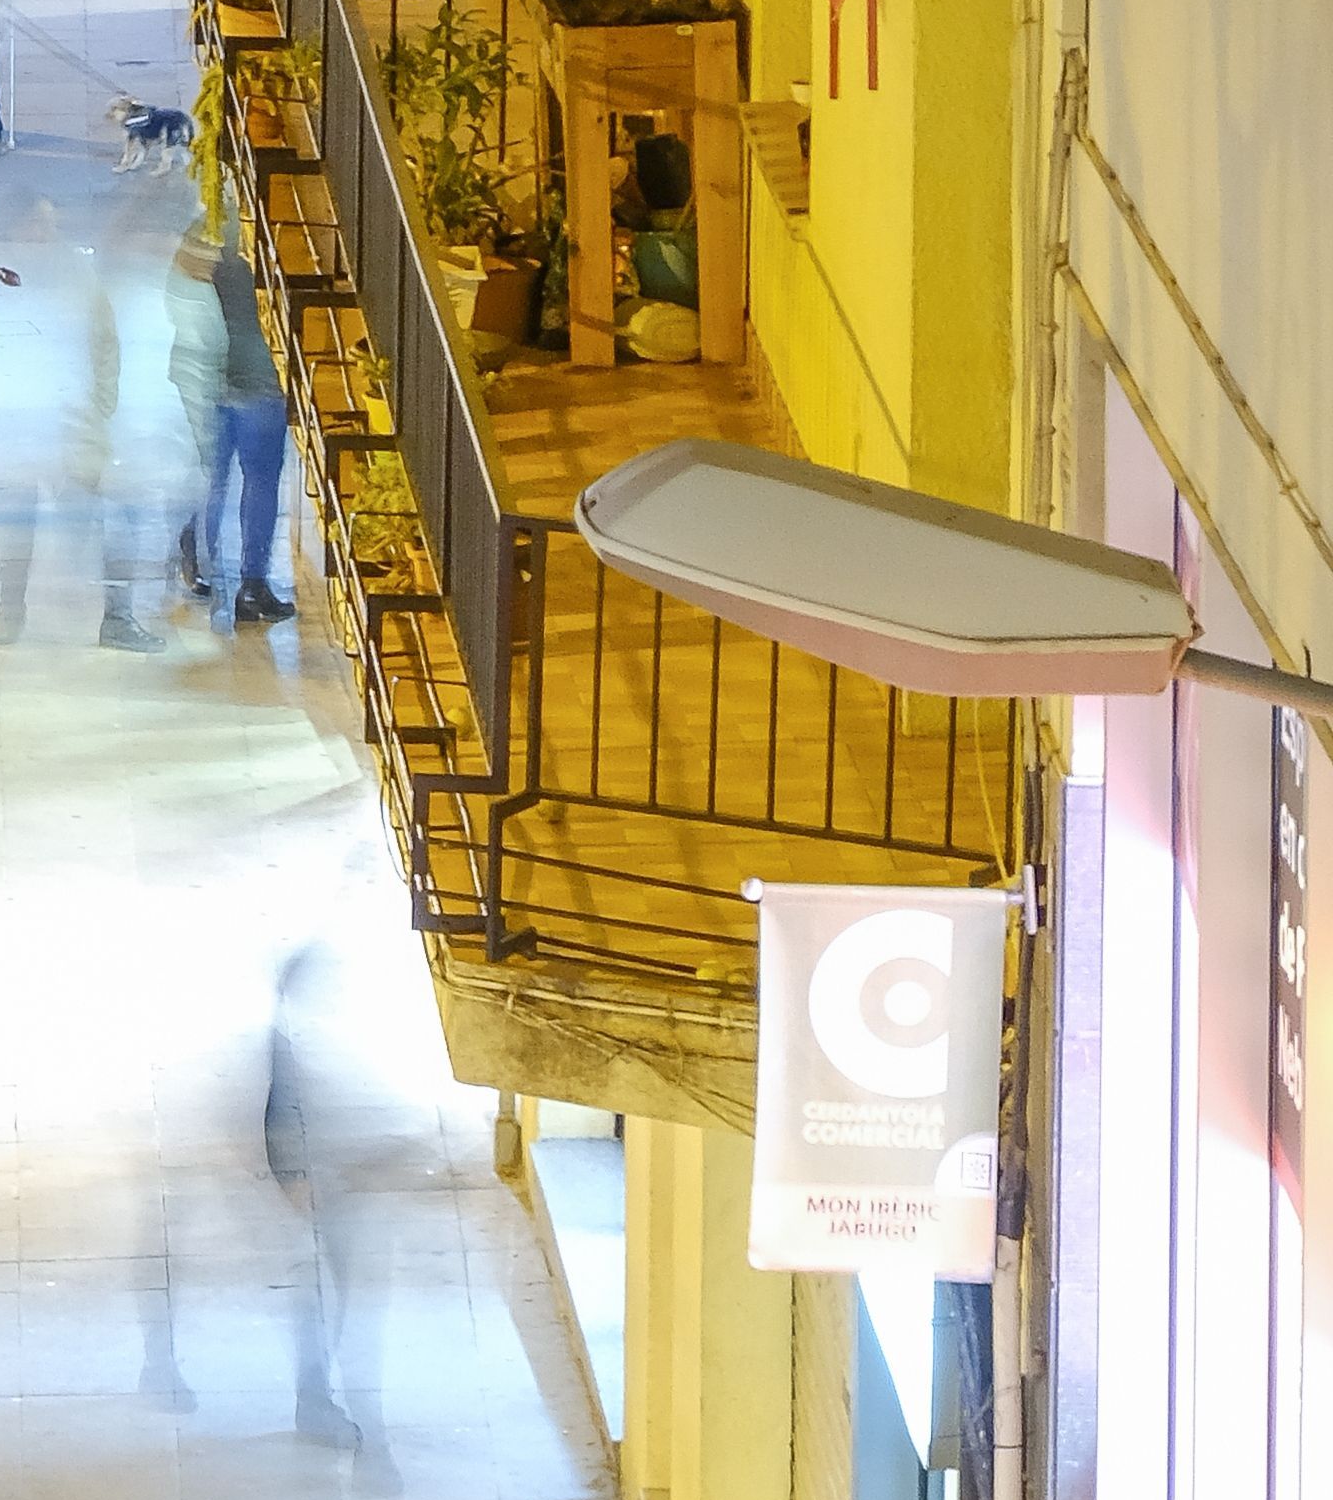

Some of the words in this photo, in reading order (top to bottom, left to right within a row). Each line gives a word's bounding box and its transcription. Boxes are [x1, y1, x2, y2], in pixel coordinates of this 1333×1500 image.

[802, 1100, 946, 1127] CERDANYOLA
[802, 1121, 946, 1150] COMERCIAL
[806, 1197, 861, 1215] MON
